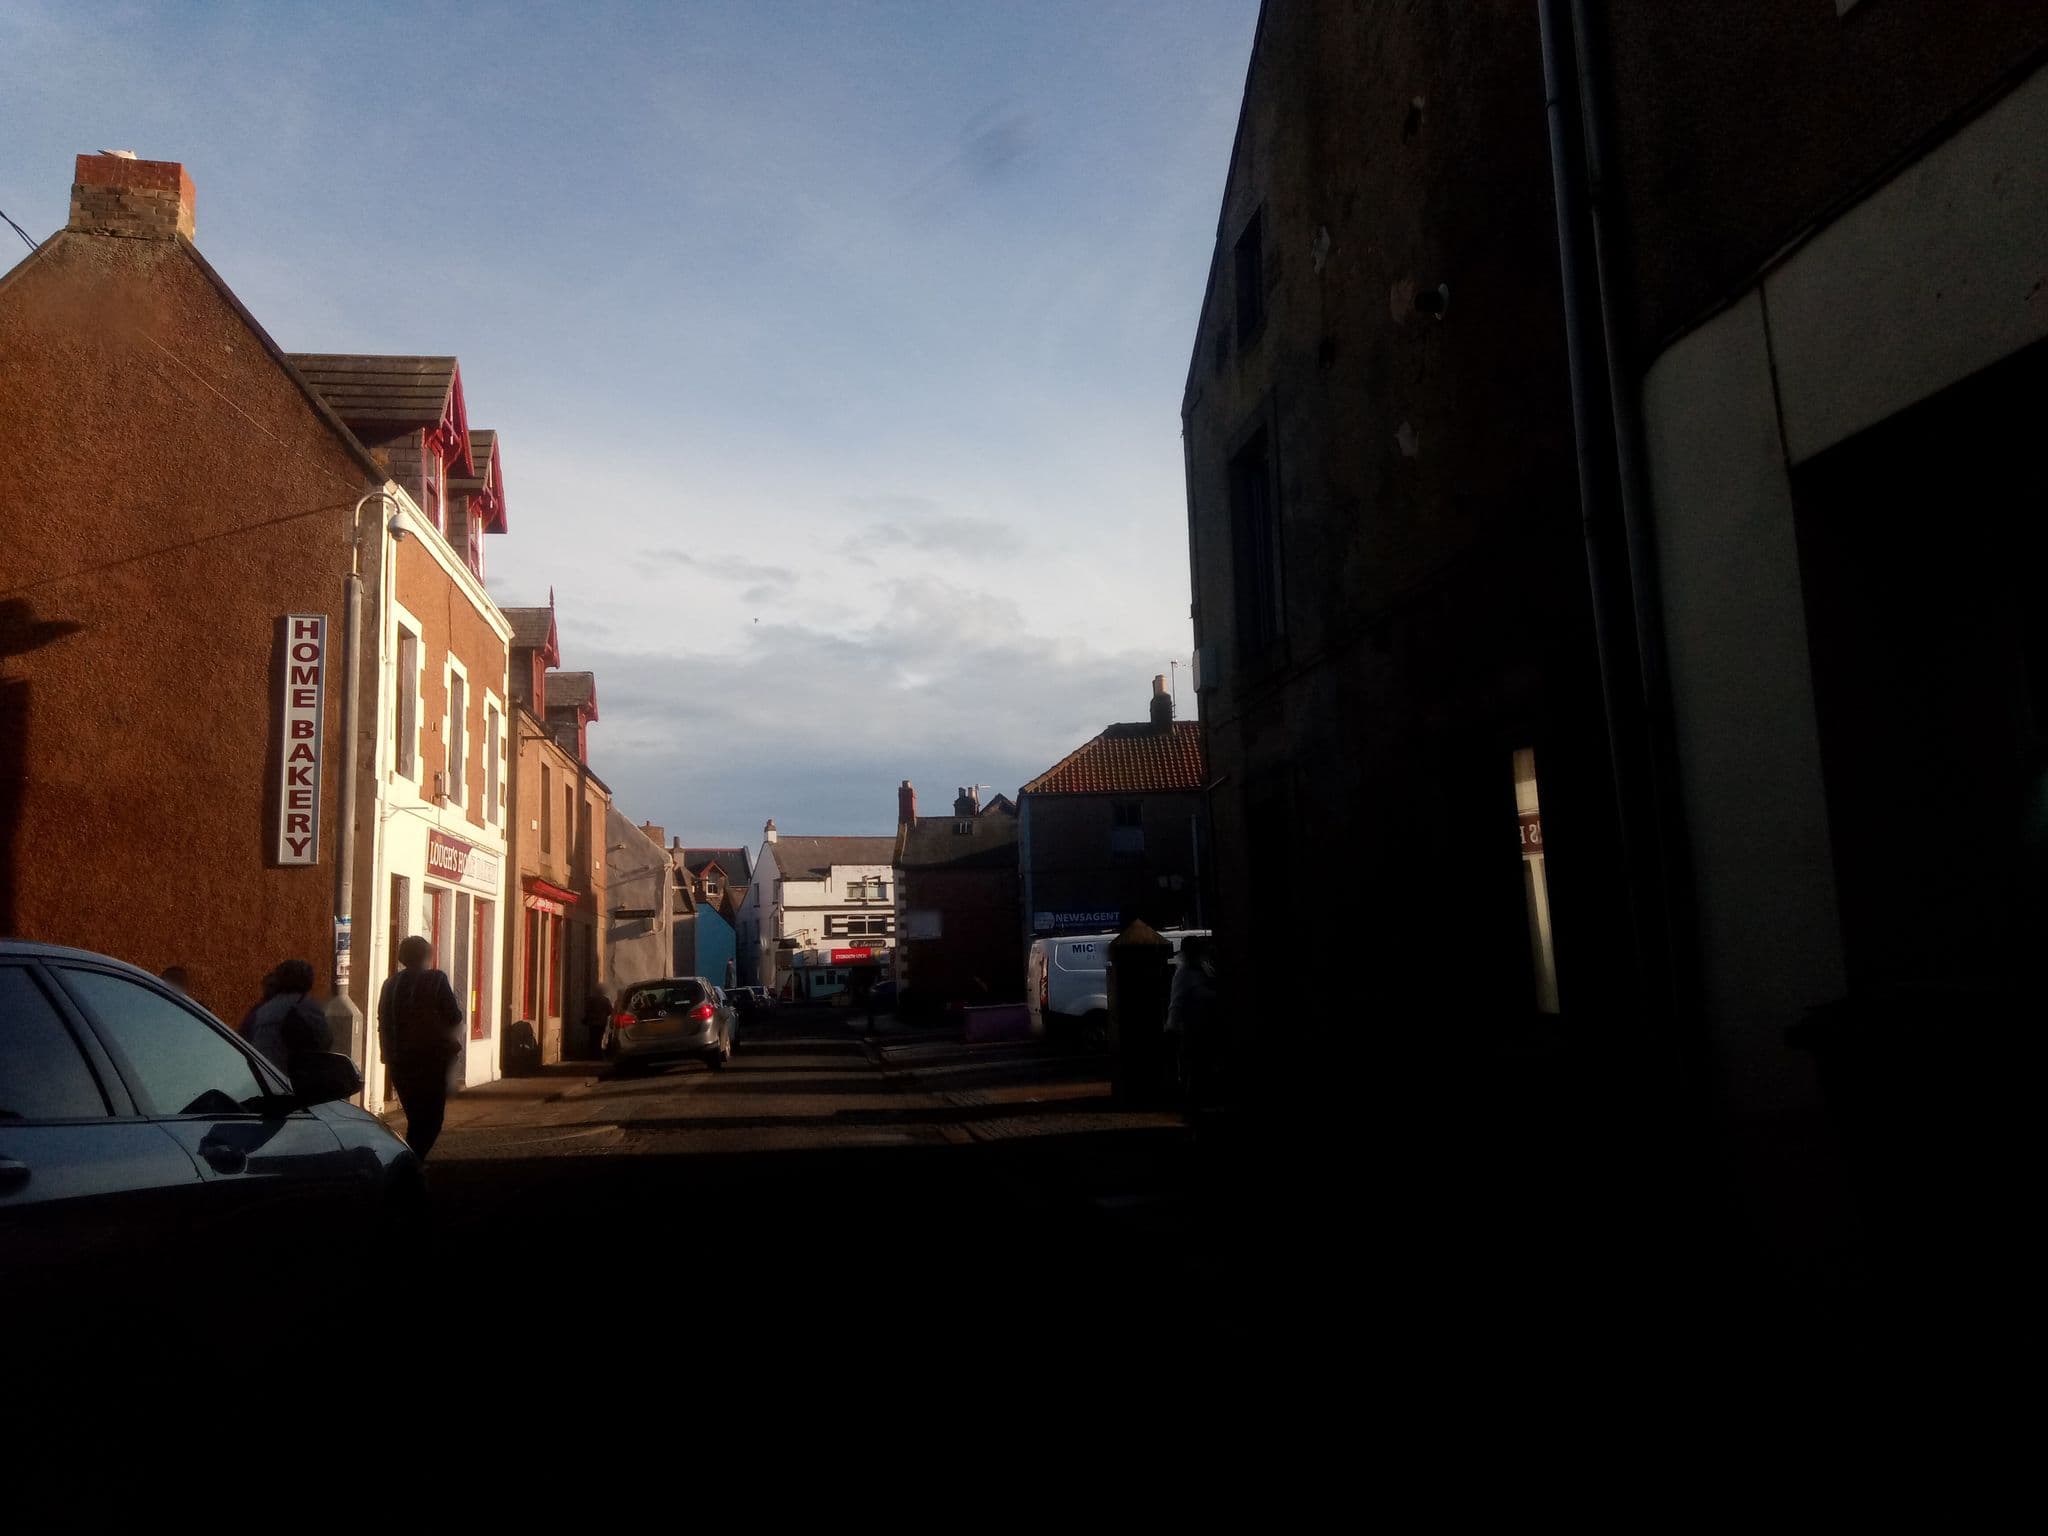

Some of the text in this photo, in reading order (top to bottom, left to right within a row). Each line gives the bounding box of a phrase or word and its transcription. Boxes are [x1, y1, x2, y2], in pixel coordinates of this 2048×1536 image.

[285, 620, 320, 857] HOME BAKERY
[429, 841, 458, 872] LOUGH'S
